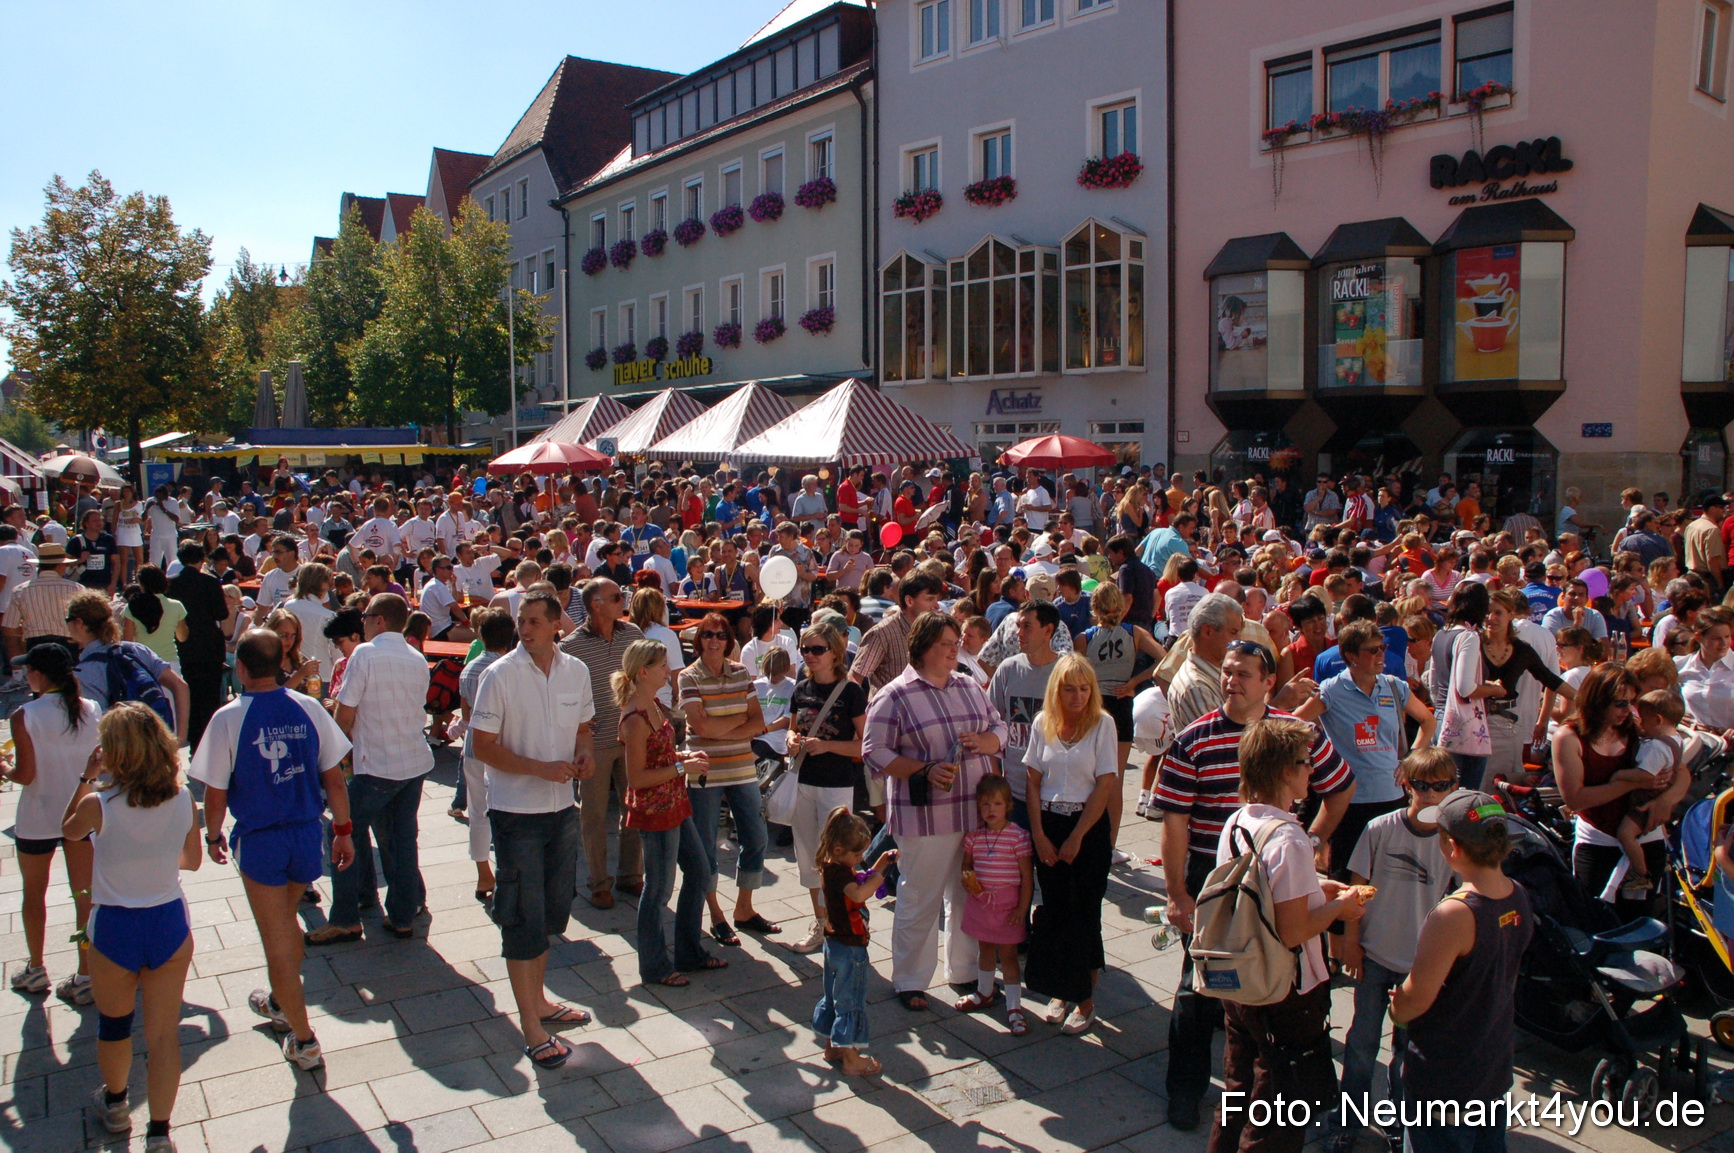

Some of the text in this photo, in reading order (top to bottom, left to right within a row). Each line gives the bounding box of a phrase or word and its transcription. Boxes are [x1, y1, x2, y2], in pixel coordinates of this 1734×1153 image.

[1430, 136, 1574, 189] RACKL
[1448, 180, 1558, 206] am Rathaus
[1353, 264, 1377, 278] Jahre
[1333, 278, 1369, 299] RACKL
[986, 388, 1043, 416] Achatz
[1248, 447, 1270, 459] RACKL
[1486, 448, 1515, 462] RACKL
